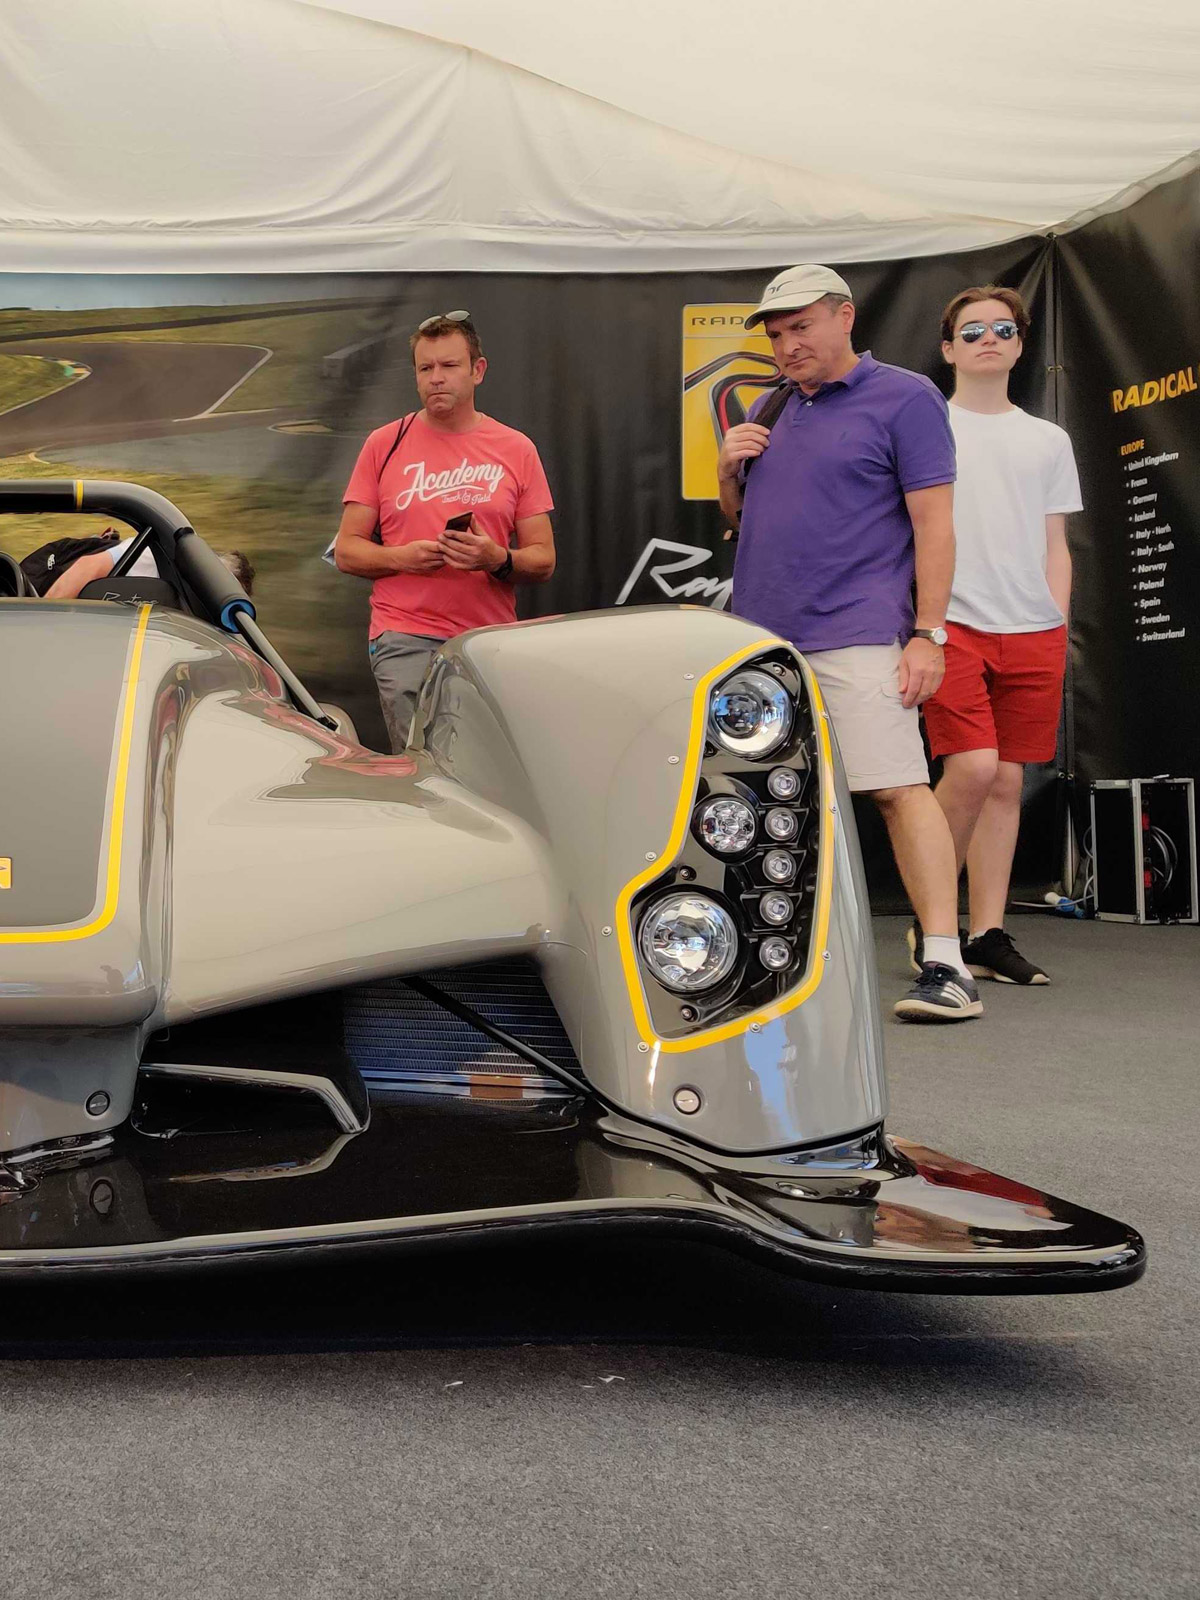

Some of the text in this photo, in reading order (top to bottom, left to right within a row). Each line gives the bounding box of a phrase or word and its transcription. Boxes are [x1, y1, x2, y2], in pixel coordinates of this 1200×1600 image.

[1112, 366, 1198, 413] RADICAL
[1121, 439, 1145, 456] EUROPE
[1128, 452, 1179, 471] United Kingdom
[396, 458, 505, 510] Academy
[1134, 508, 1156, 522] Iceland
[1135, 528, 1151, 540] Italy
[1155, 523, 1172, 535] North
[1137, 545, 1153, 557] Italy
[1158, 540, 1175, 552] South
[1138, 562, 1167, 573] Norway
[1139, 577, 1165, 591] Poland
[1140, 596, 1161, 609] Spain
[1141, 612, 1171, 625] Sweden
[1142, 627, 1186, 642] Switzerland
